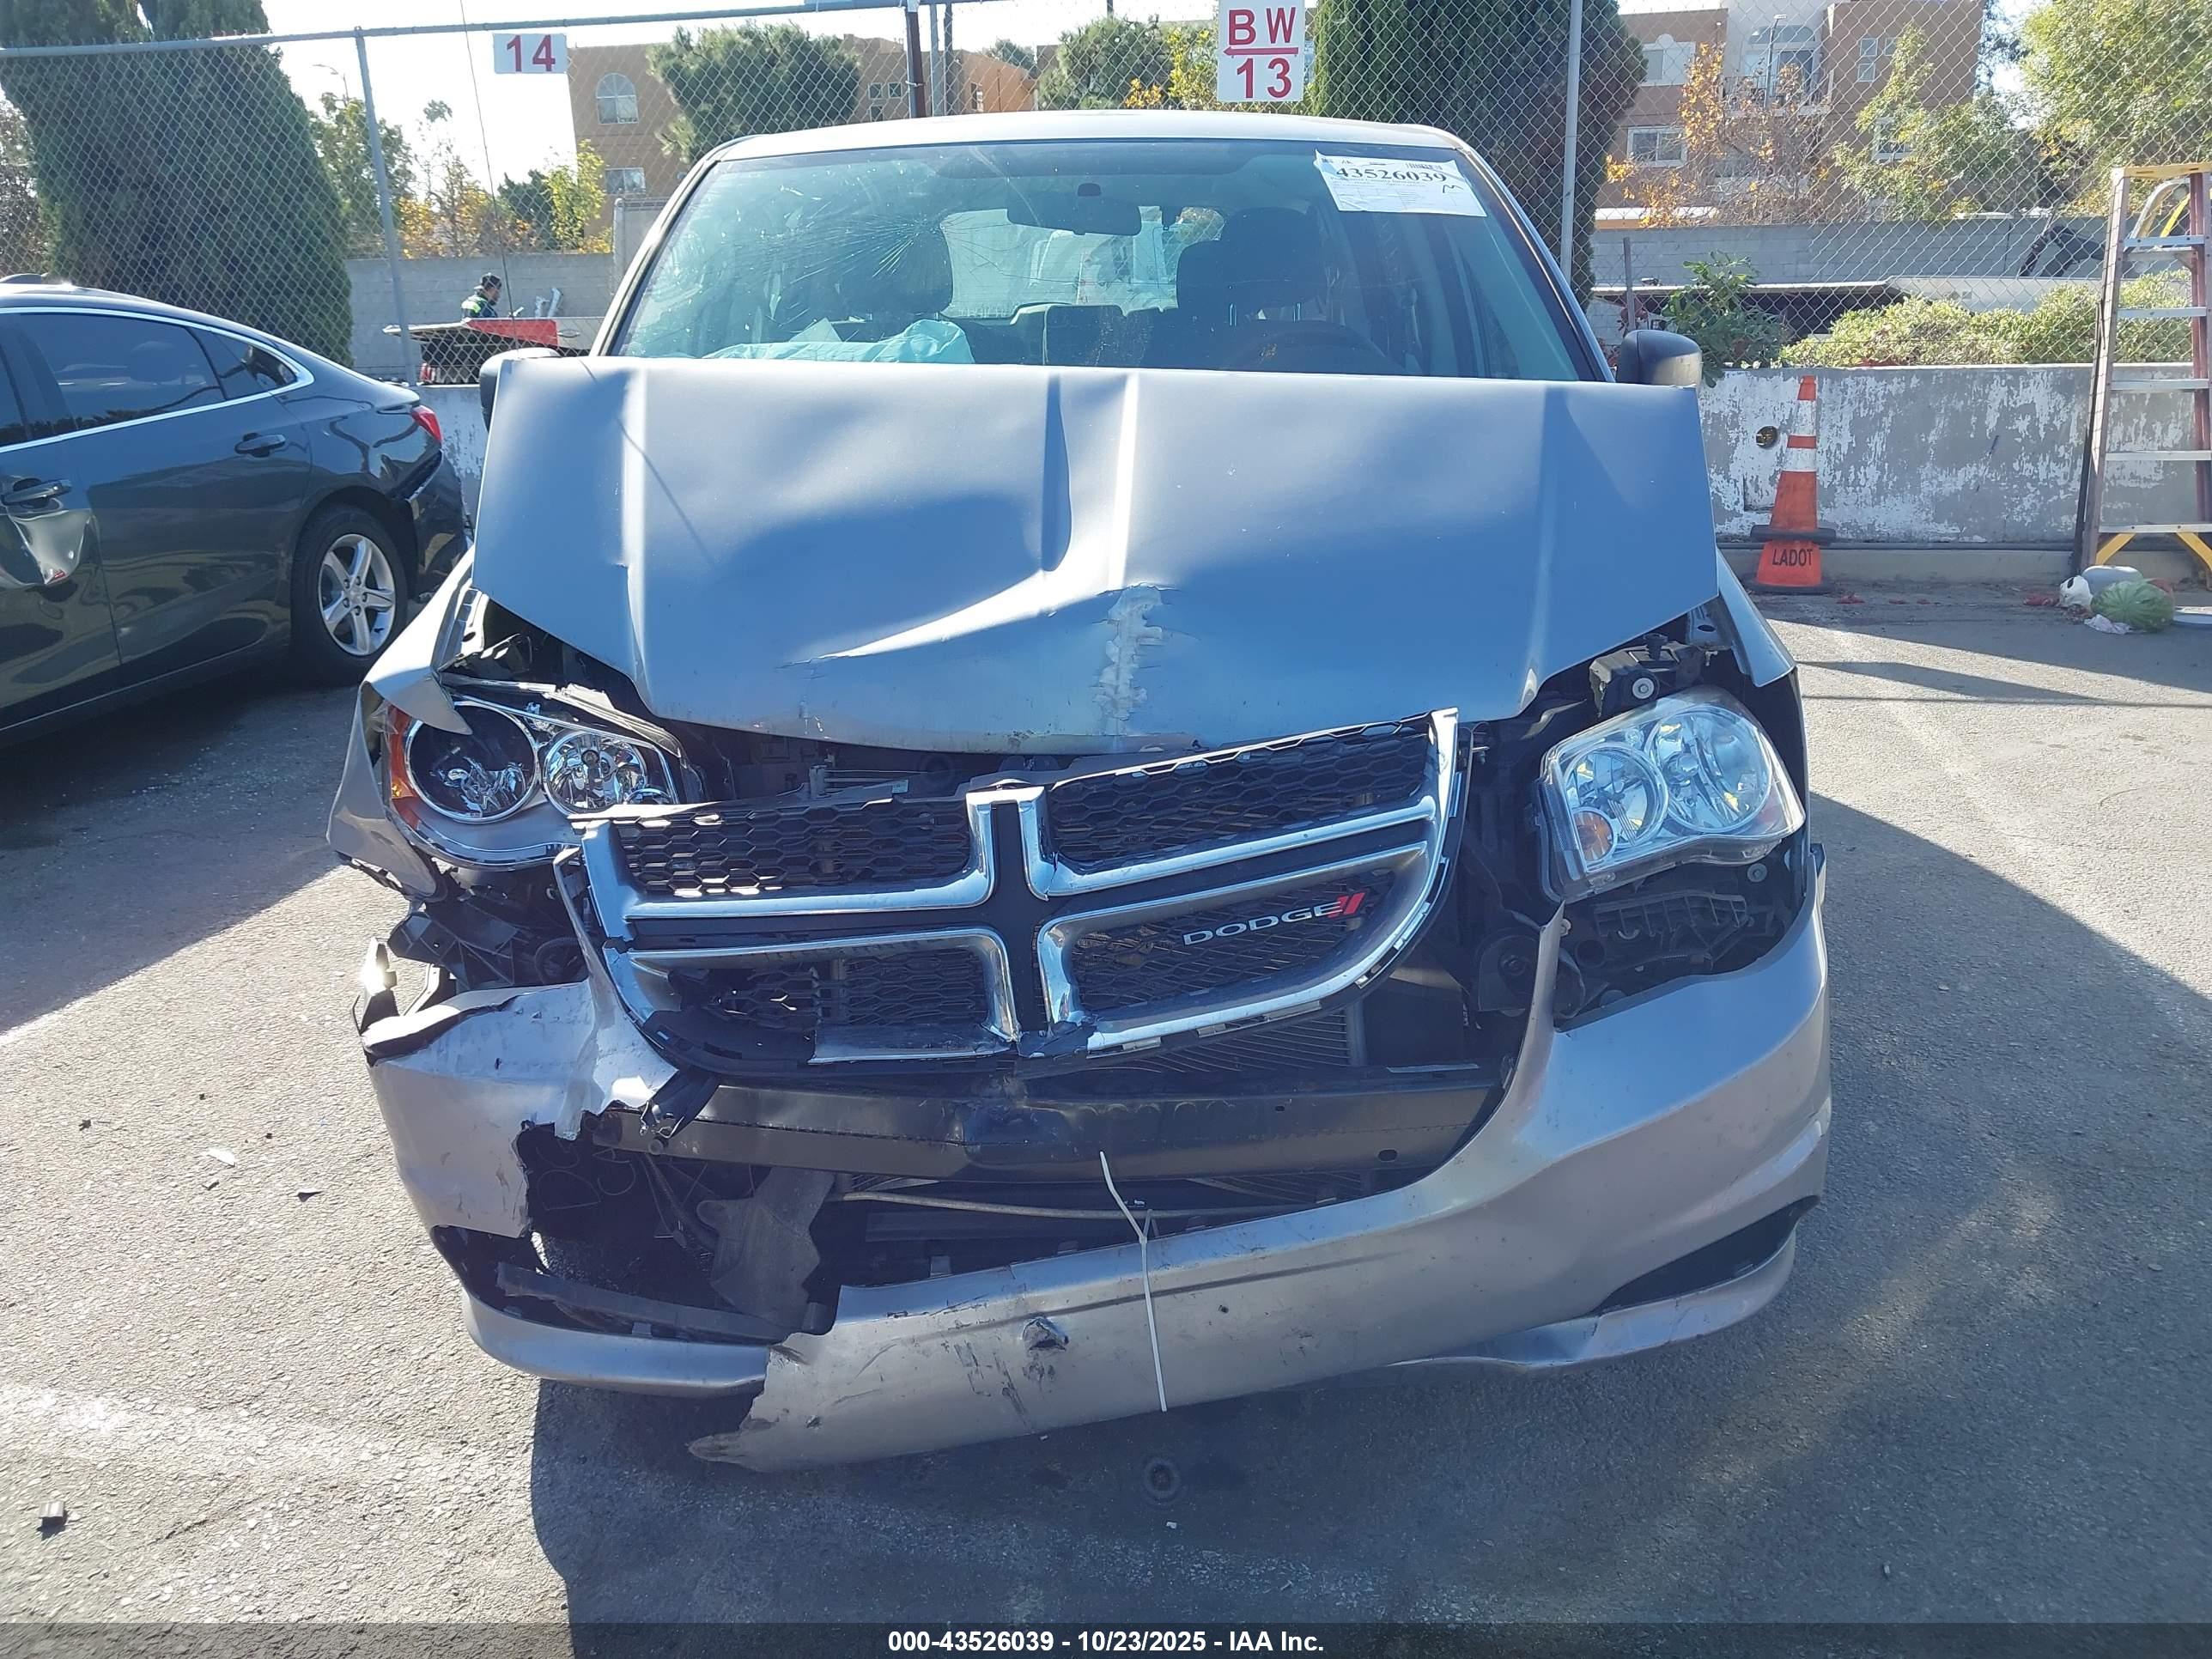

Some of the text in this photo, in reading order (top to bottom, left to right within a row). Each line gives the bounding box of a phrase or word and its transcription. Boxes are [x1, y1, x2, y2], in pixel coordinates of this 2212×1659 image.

[507, 34, 556, 72] 14
[1237, 58, 1291, 99] 13
[1336, 167, 1447, 182] 43526039
[1771, 549, 1813, 567] LADOT
[1183, 901, 1343, 945] DODGE
